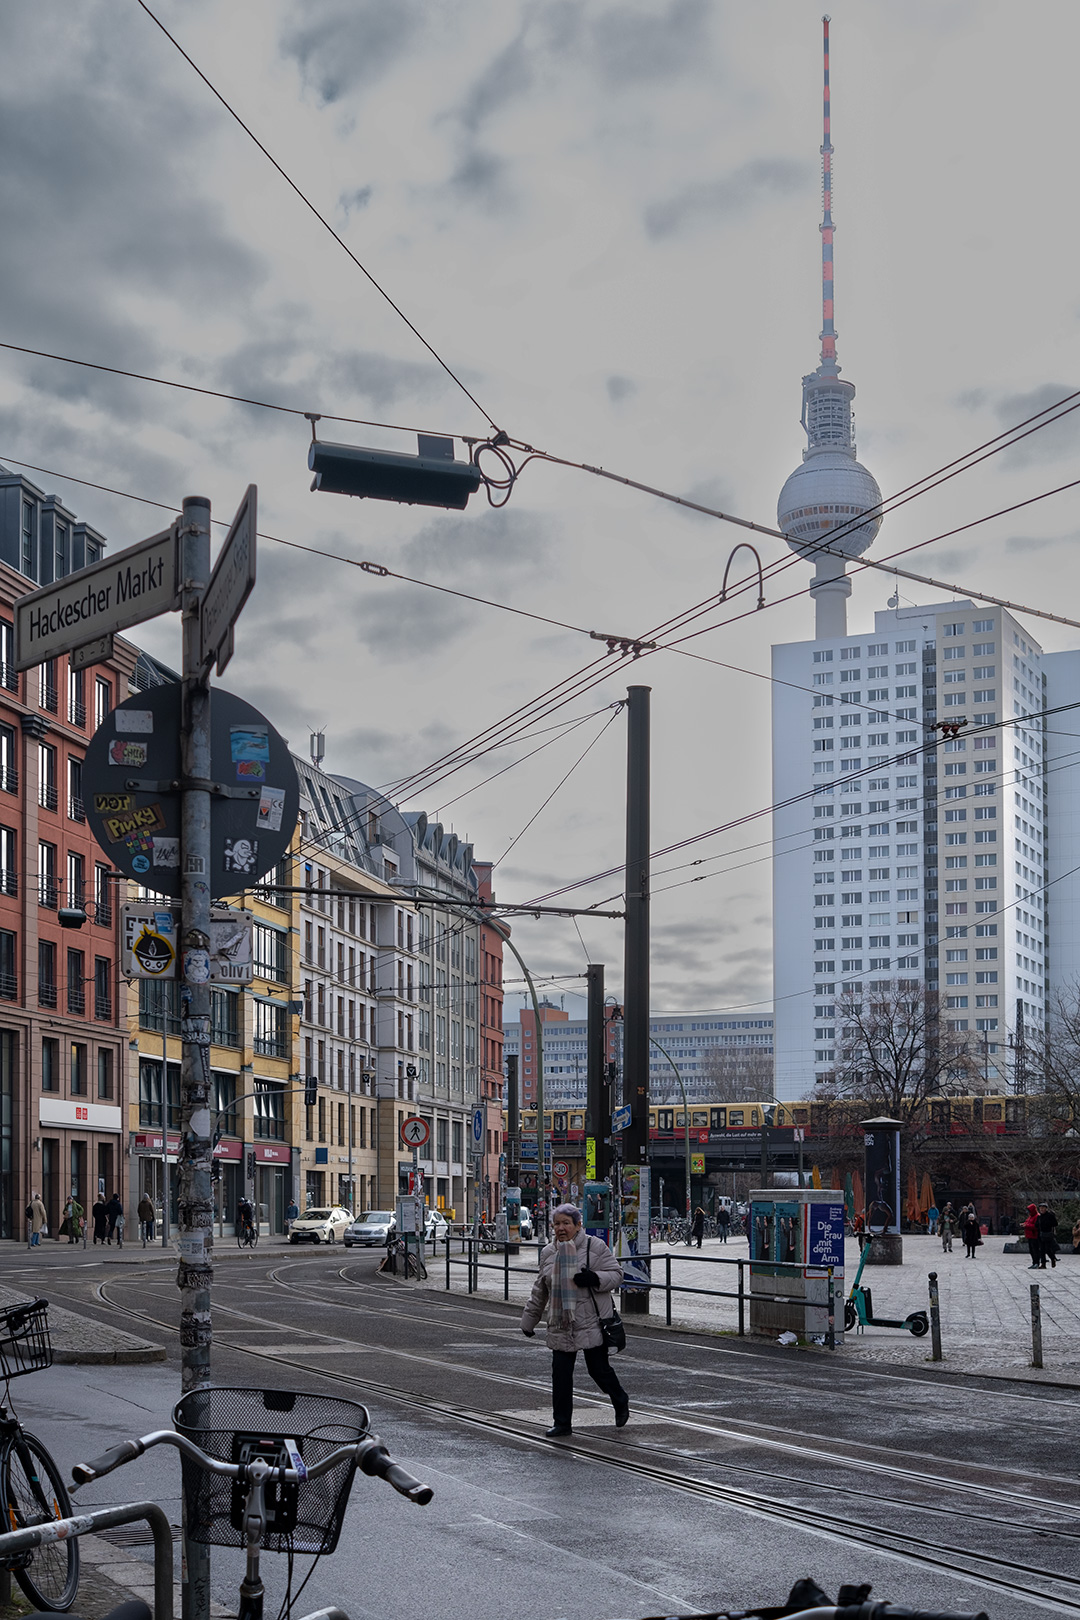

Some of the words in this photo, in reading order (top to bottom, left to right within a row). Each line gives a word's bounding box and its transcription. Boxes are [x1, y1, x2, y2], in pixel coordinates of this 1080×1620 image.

[29, 584, 112, 642] Hackescher
[116, 556, 164, 605] Markt
[79, 651, 85, 662] 3
[817, 1221, 832, 1230] Die
[824, 1230, 842, 1240] Frau
[818, 1238, 832, 1247] mit
[812, 1244, 832, 1253] dem
[821, 1253, 839, 1262] Arm
